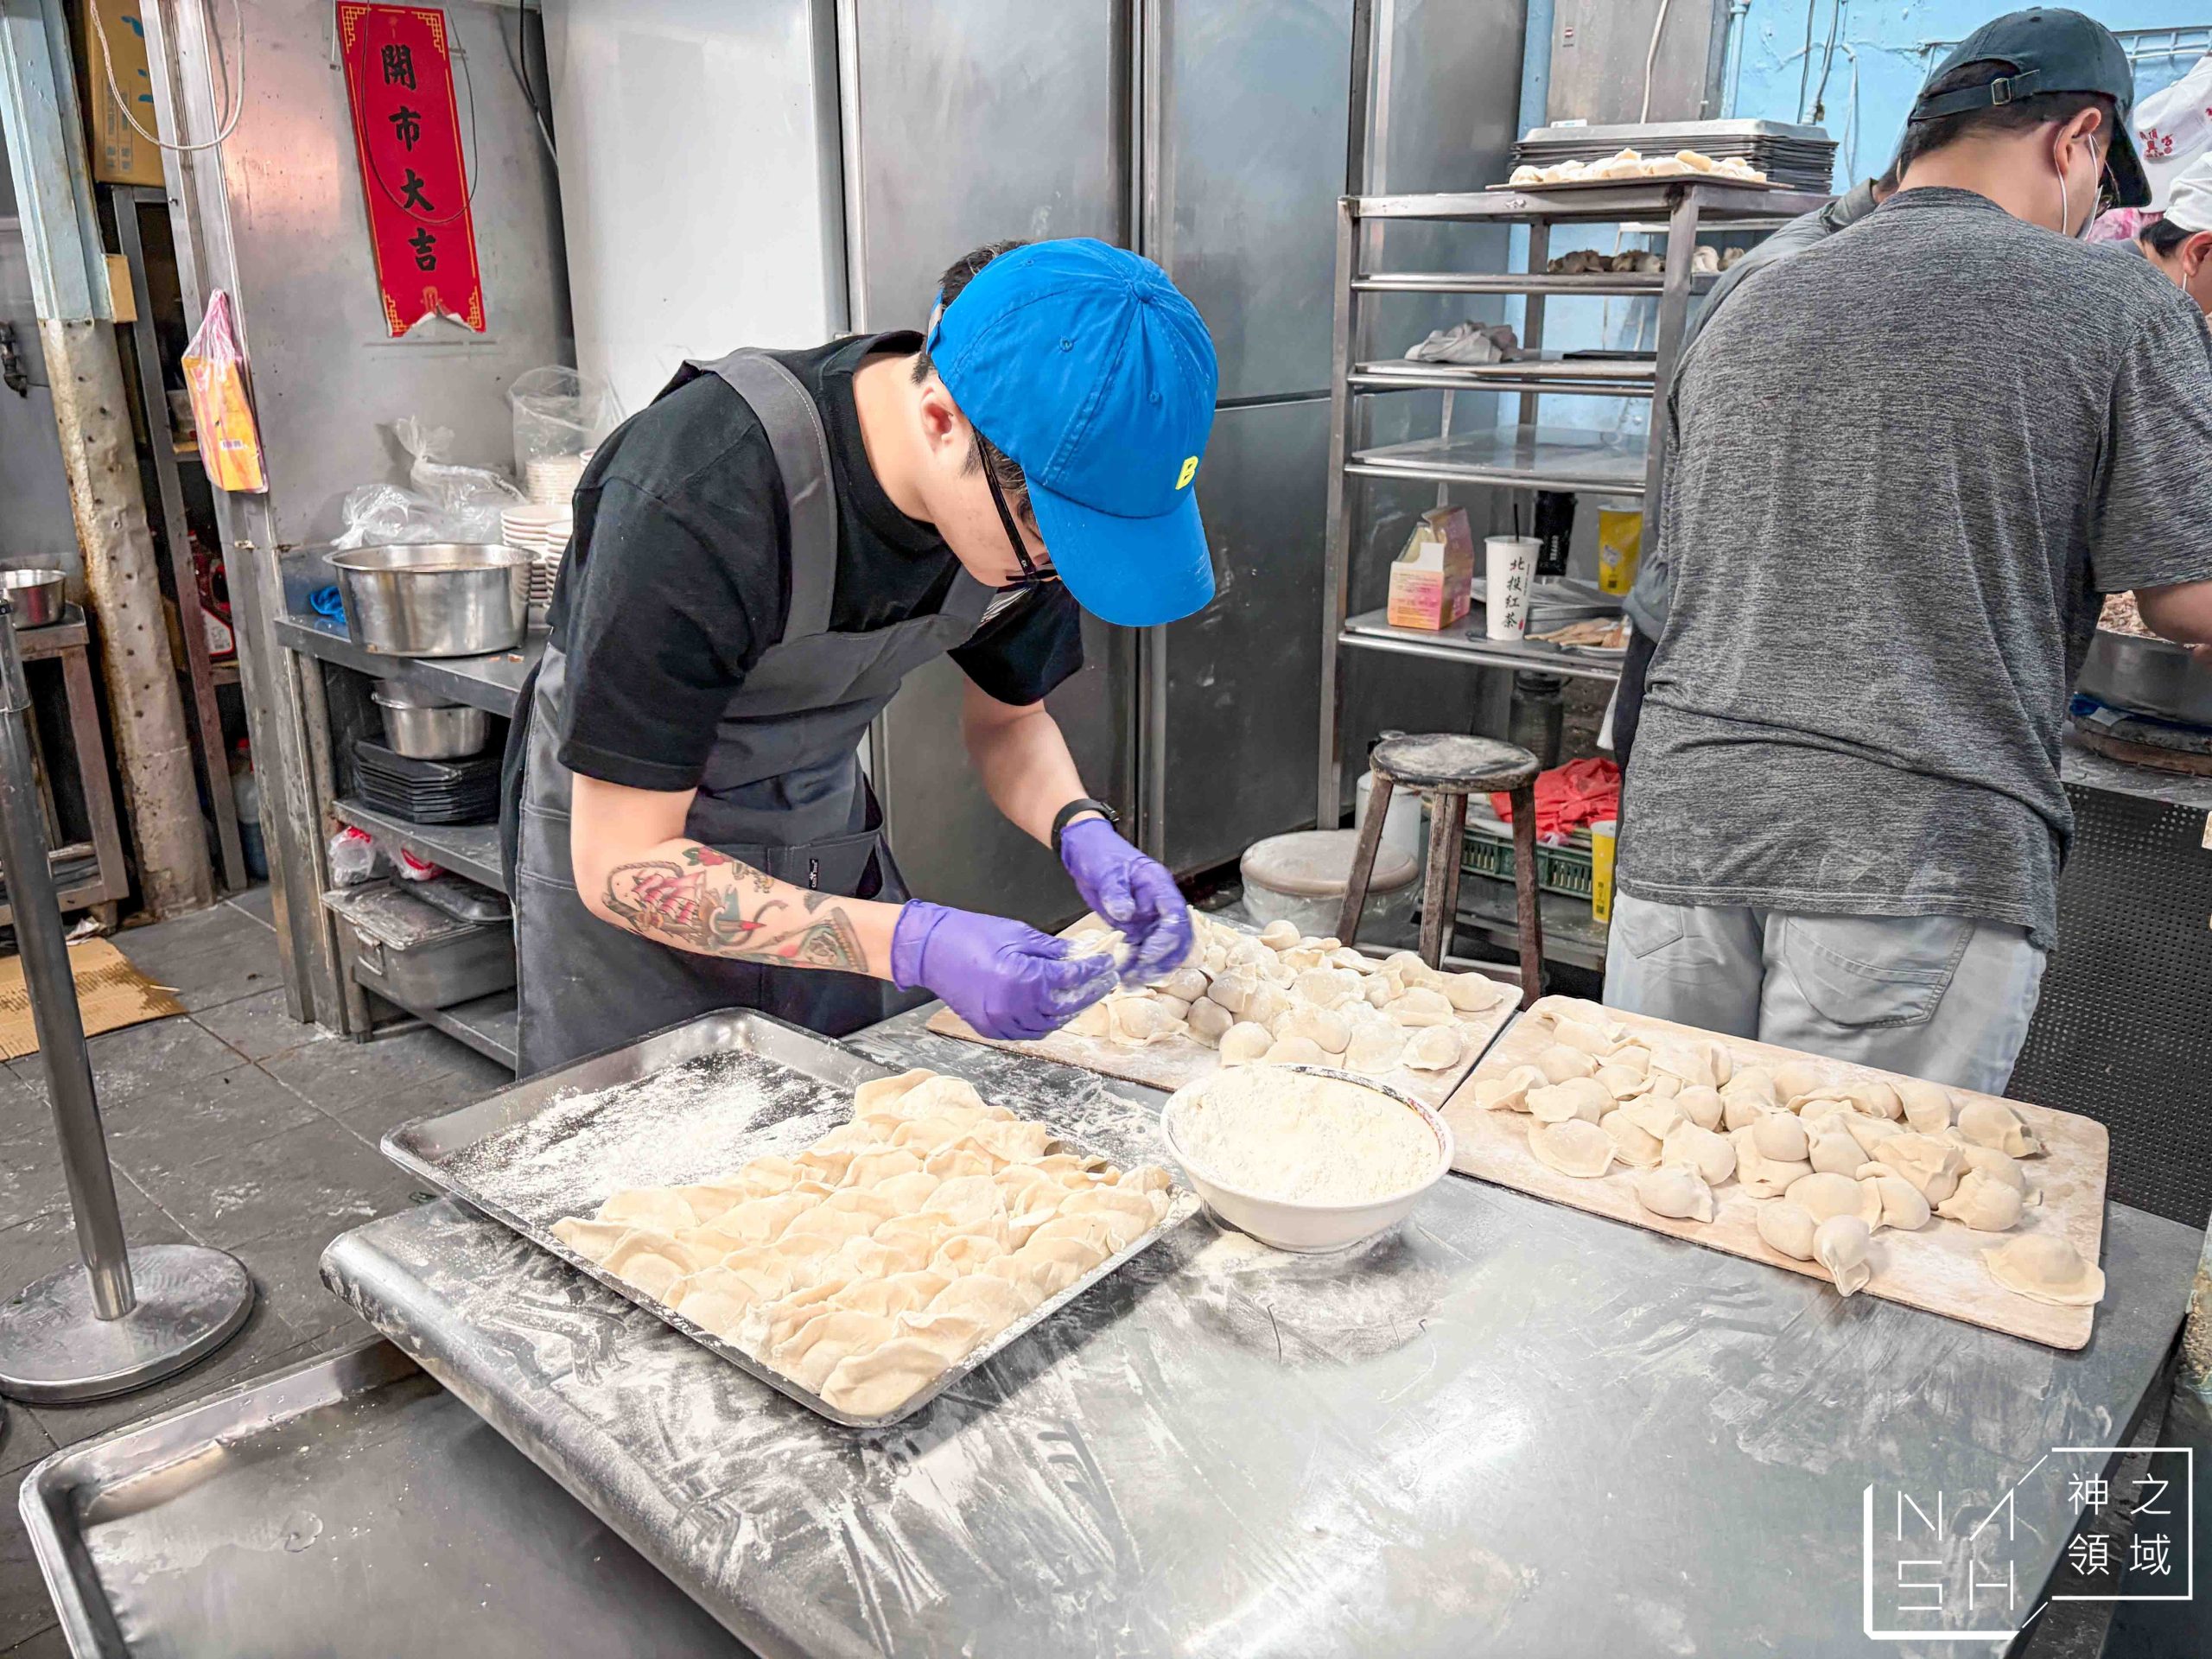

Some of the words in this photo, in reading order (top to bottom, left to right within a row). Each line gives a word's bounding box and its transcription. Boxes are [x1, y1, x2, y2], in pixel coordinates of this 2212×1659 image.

[381, 44, 436, 271] 開市大吉
[1175, 455, 1198, 490] B
[1503, 556, 1524, 628] 北投紅茶
